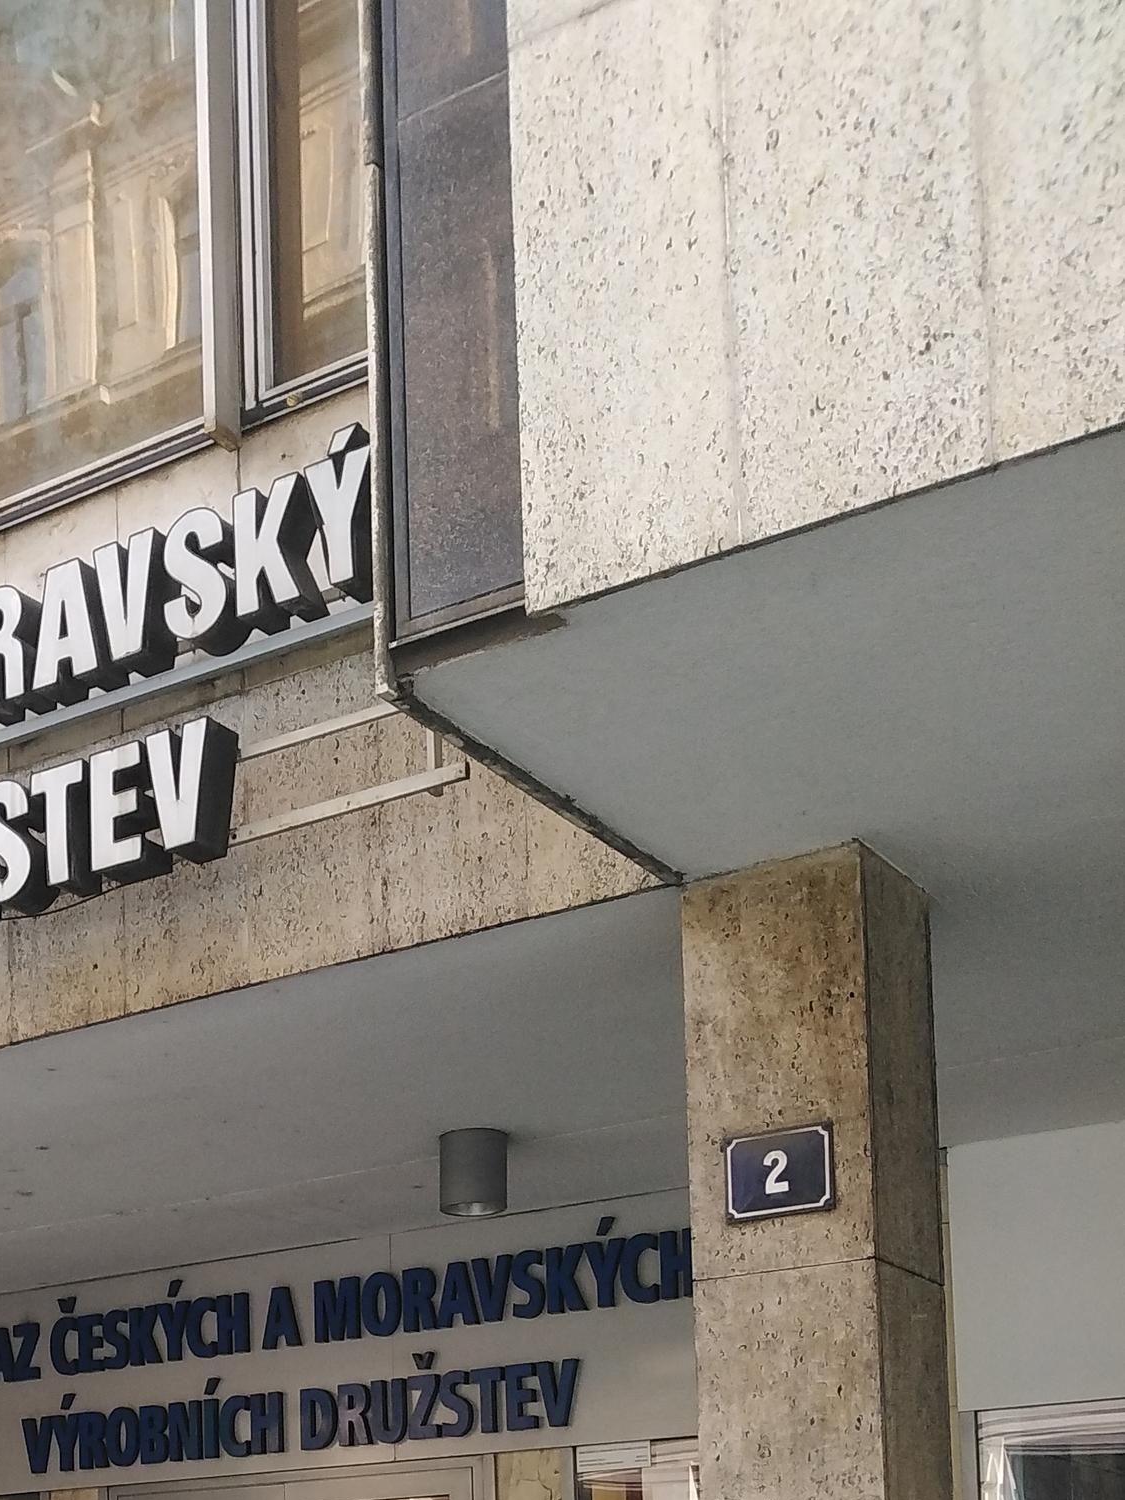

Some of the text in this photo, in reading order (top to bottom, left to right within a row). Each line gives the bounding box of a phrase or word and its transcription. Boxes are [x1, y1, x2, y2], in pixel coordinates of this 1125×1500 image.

[763, 1150, 789, 1194] 2
[50, 1279, 250, 1375] ČESKÝCH
[263, 1286, 303, 1351] A
[314, 1216, 693, 1344] MORAVSKÝCH
[22, 1351, 580, 1474] VÝROBNÍCH DRUŽSTEV
